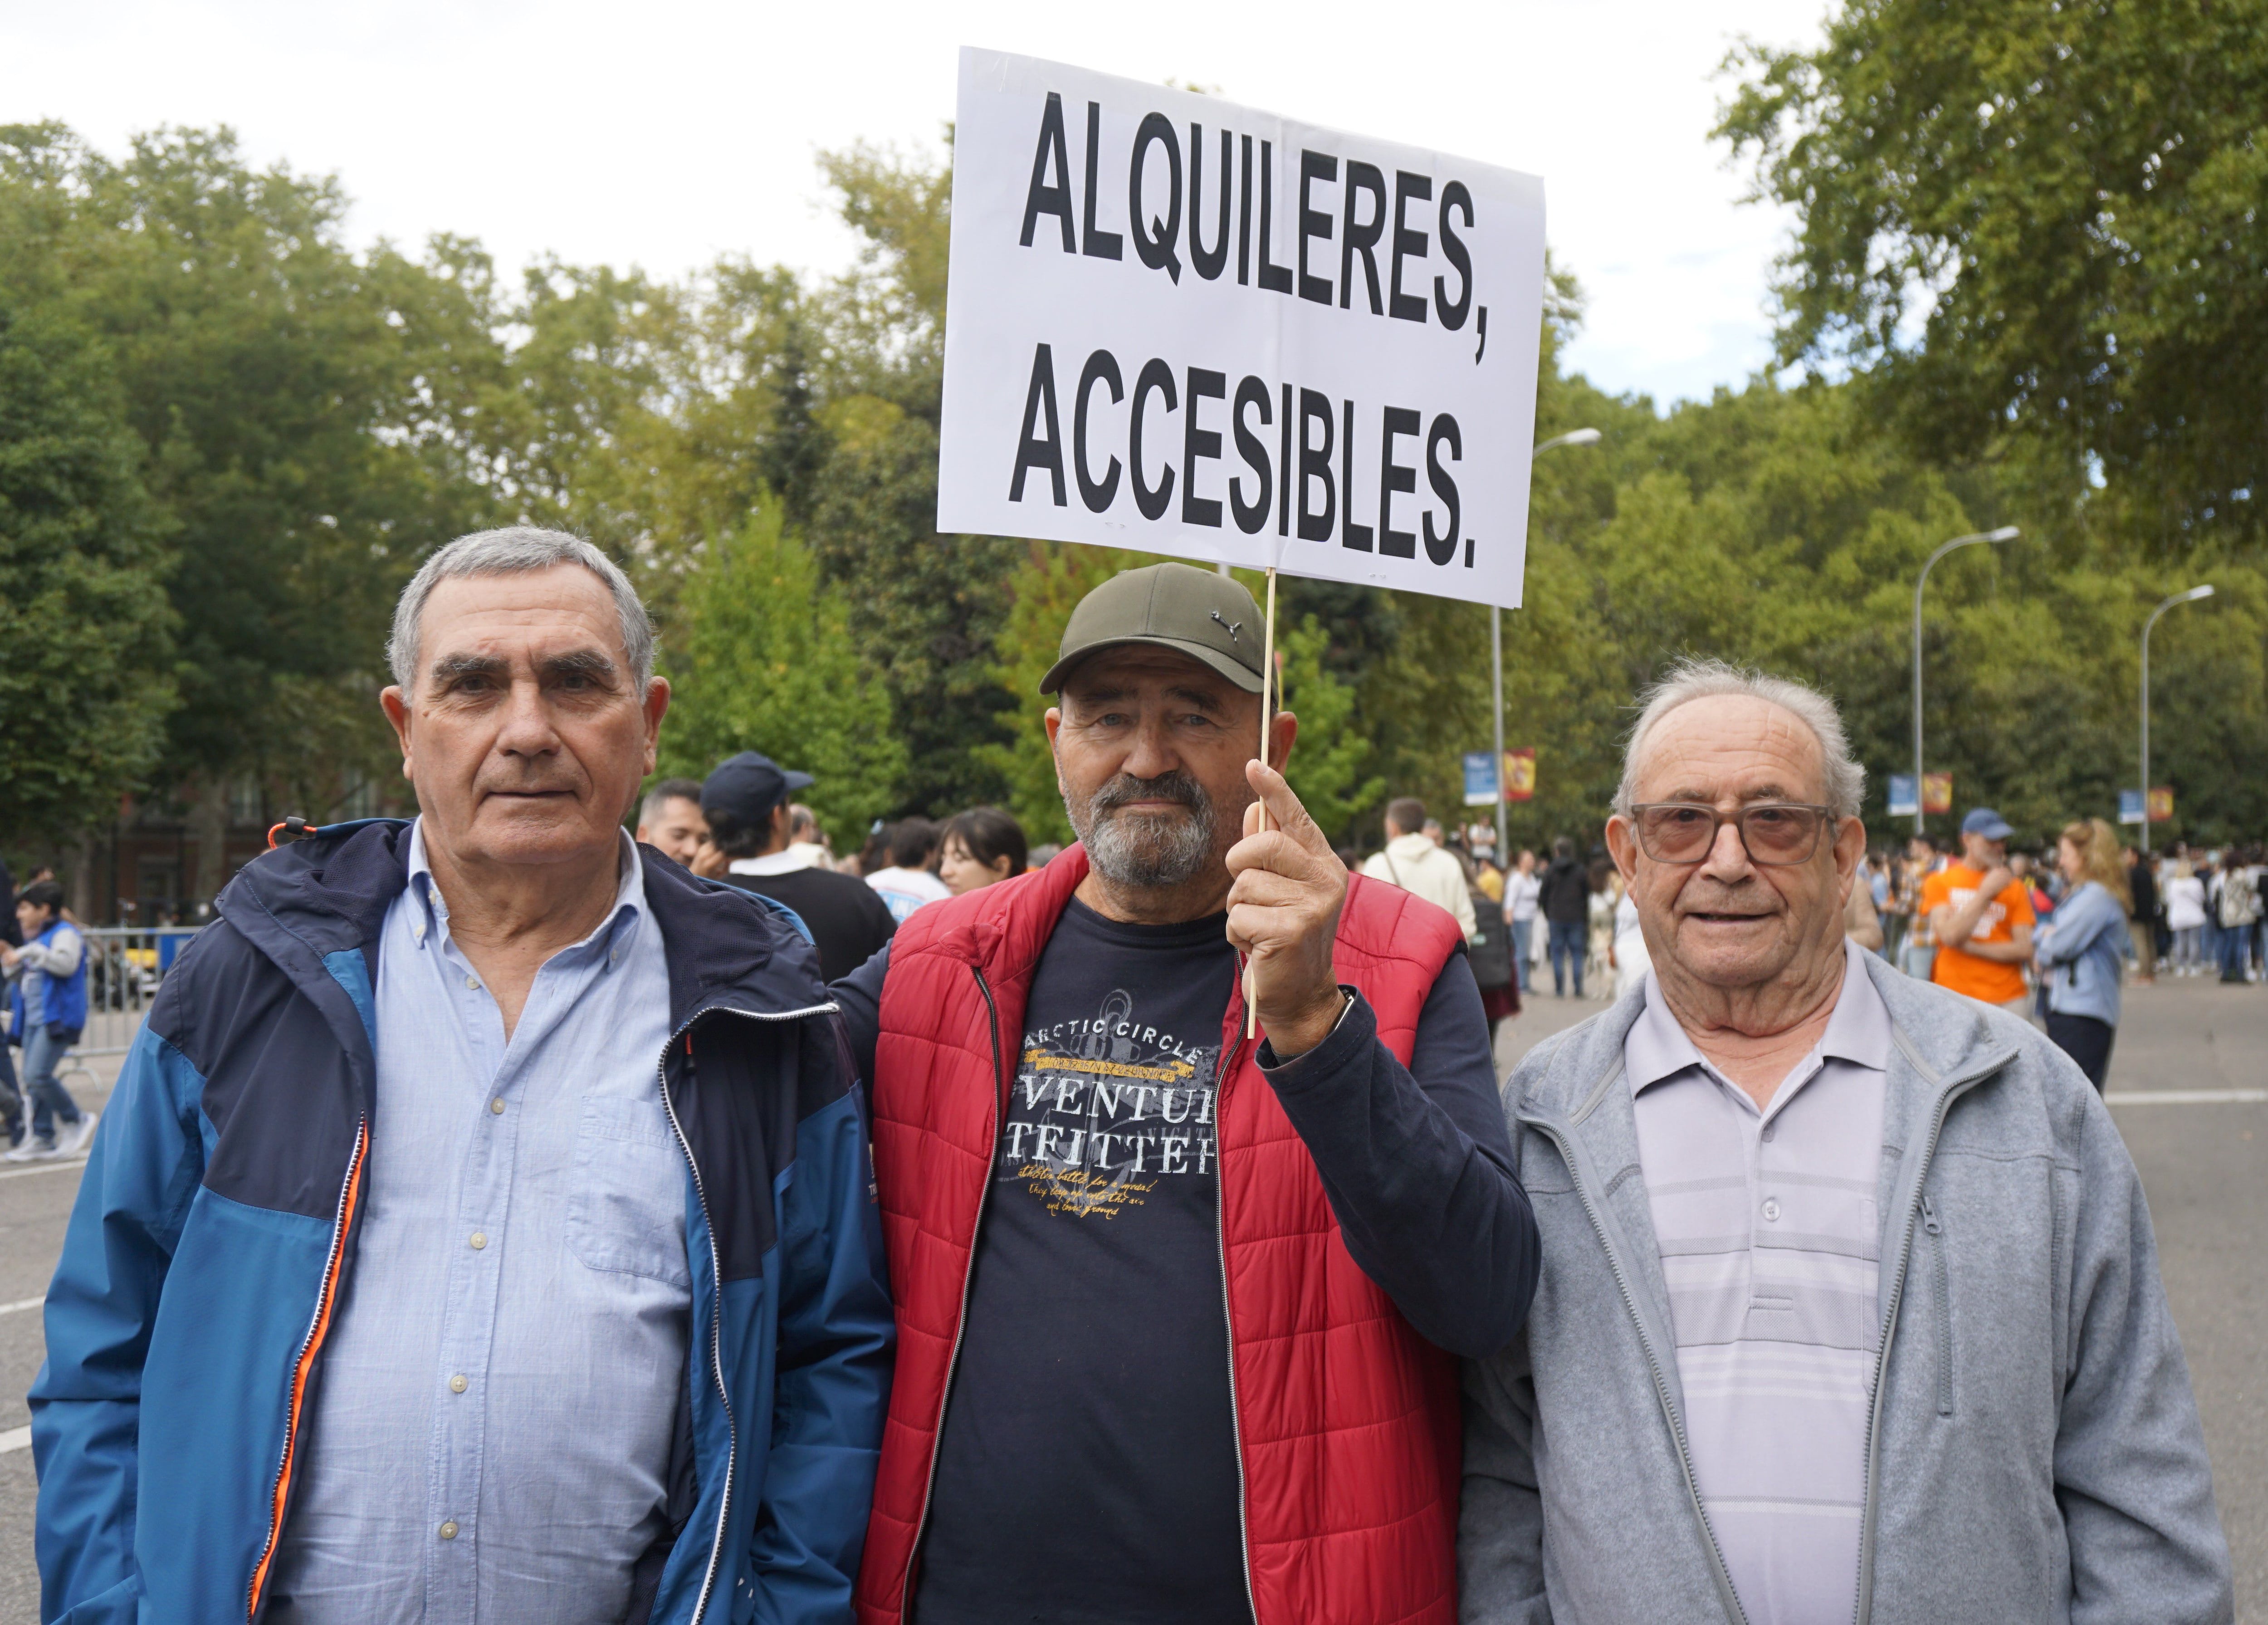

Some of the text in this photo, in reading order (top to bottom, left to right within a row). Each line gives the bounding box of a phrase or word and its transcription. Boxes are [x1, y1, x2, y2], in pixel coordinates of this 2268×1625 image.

[1019, 92, 1487, 366] ALQUILERES,
[1009, 343, 1475, 568] ACCESIBLES.
[1024, 1019, 1202, 1065] ARCTIC CIRCLE
[1085, 1175, 1107, 1189] for
[1046, 1202, 1060, 1217] and
